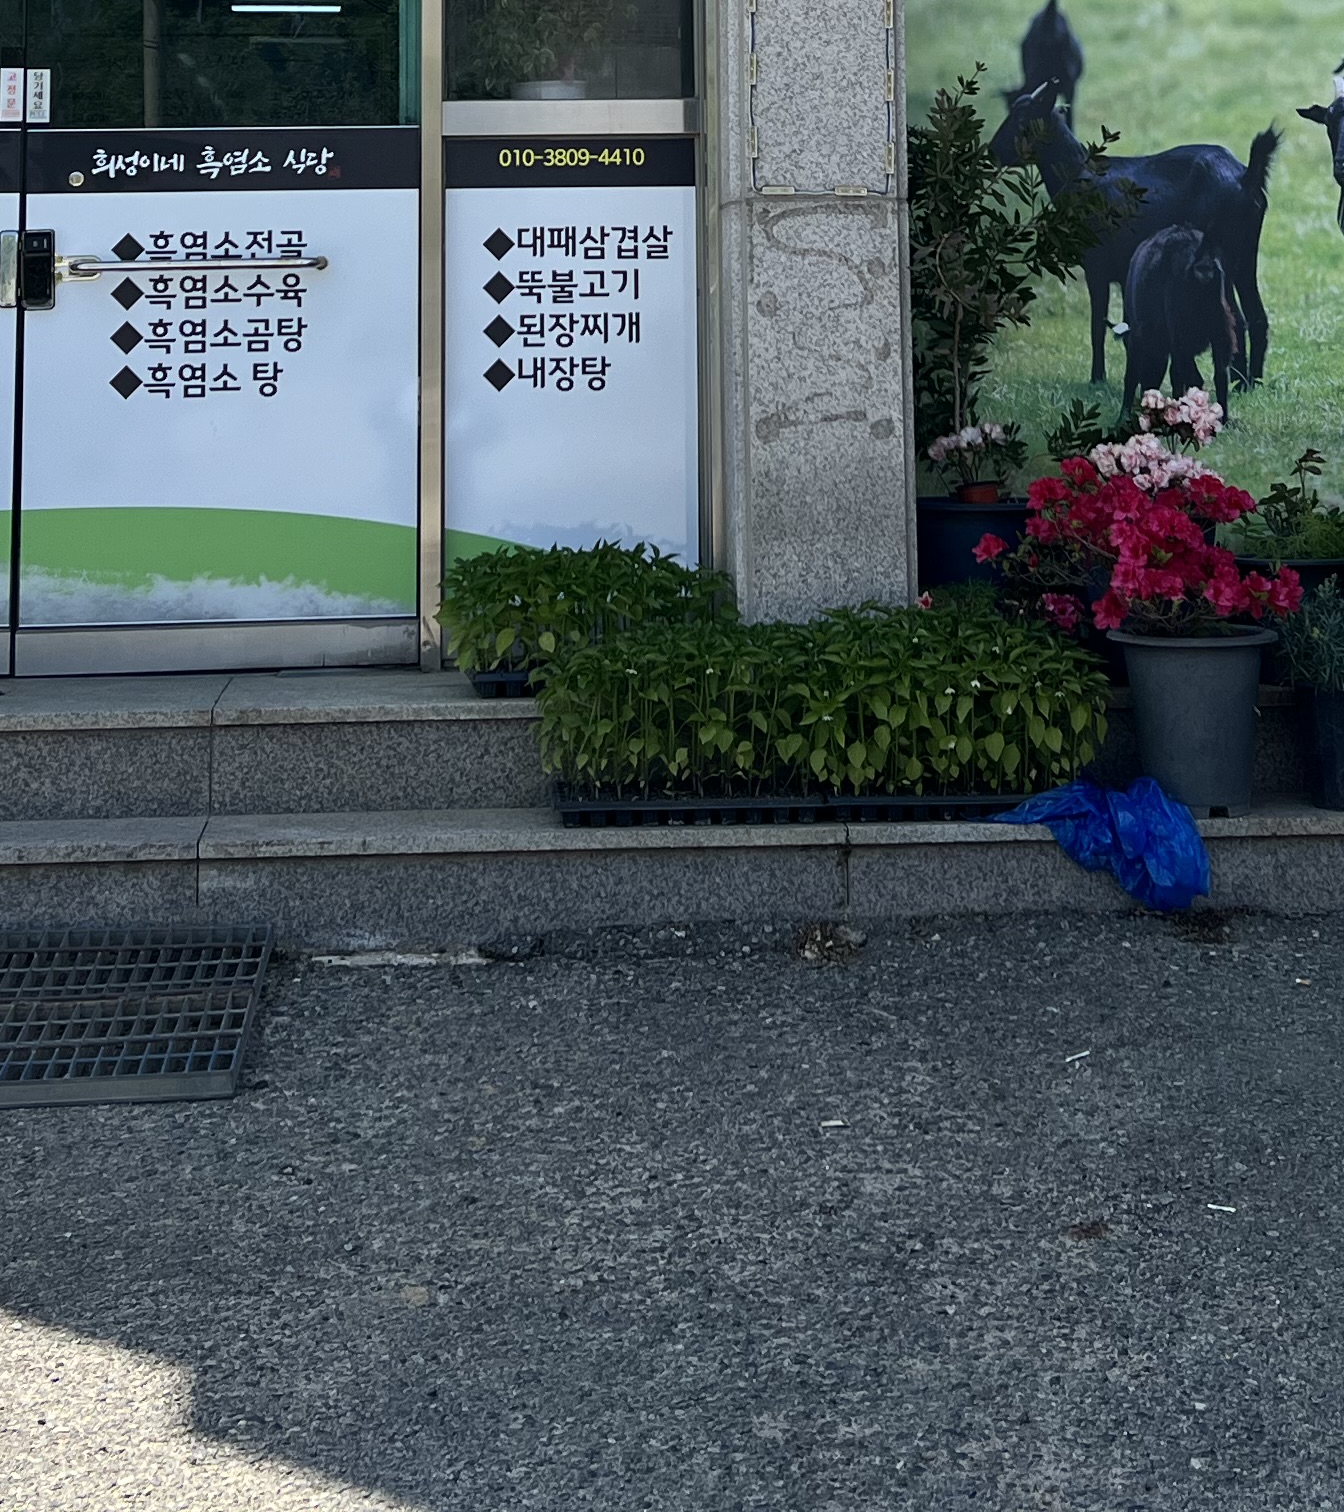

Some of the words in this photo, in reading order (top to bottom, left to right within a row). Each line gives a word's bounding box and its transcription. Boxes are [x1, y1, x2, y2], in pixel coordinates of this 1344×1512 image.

[33, 71, 44, 110] 당기세요
[91, 148, 185, 178] 희성이네
[196, 146, 272, 178] 흑염소
[283, 147, 335, 179] 식당
[498, 146, 645, 169] 010-3809-4410
[145, 230, 308, 261] 흑염소전골
[515, 224, 673, 261] 대패삼겹살
[144, 273, 308, 309] 흑염소수육
[514, 268, 641, 303] 뚝불고기
[144, 317, 308, 355] 흑염소곰탕
[515, 310, 642, 348] 된장찌개
[144, 363, 243, 399] 흑염소
[252, 360, 284, 398] 탕
[515, 354, 612, 393] 내장탕
